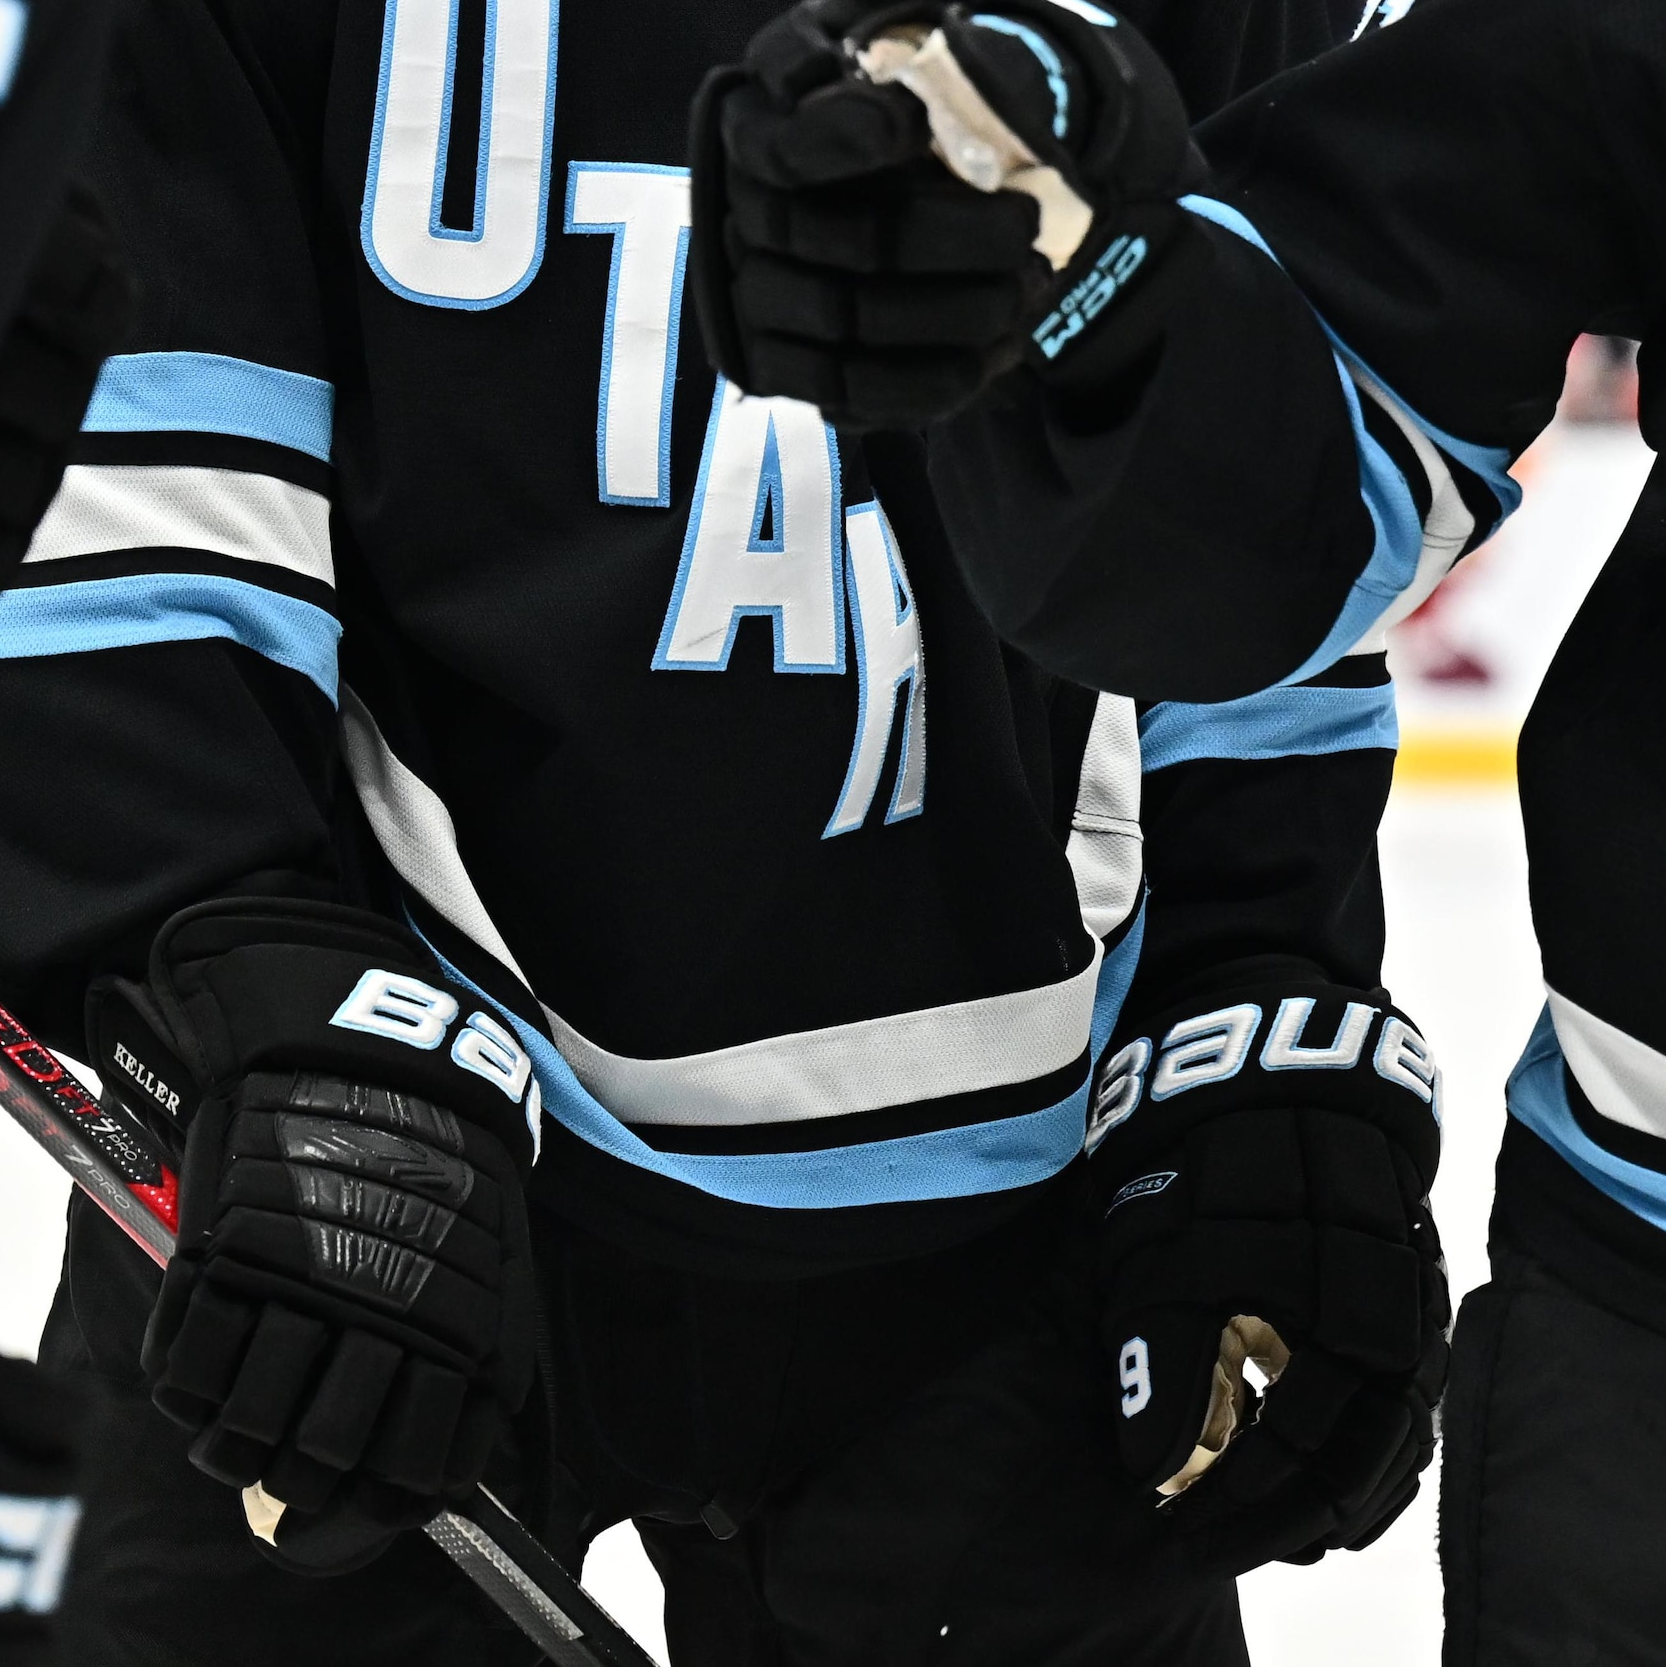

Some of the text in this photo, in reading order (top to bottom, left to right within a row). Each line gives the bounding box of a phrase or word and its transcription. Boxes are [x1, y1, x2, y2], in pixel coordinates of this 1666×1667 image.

[1041, 237, 1147, 358] CCM
[113, 1042, 181, 1116] KELLER
[106, 1133, 138, 1161] PRO
[1119, 1336, 1151, 1418] 9
